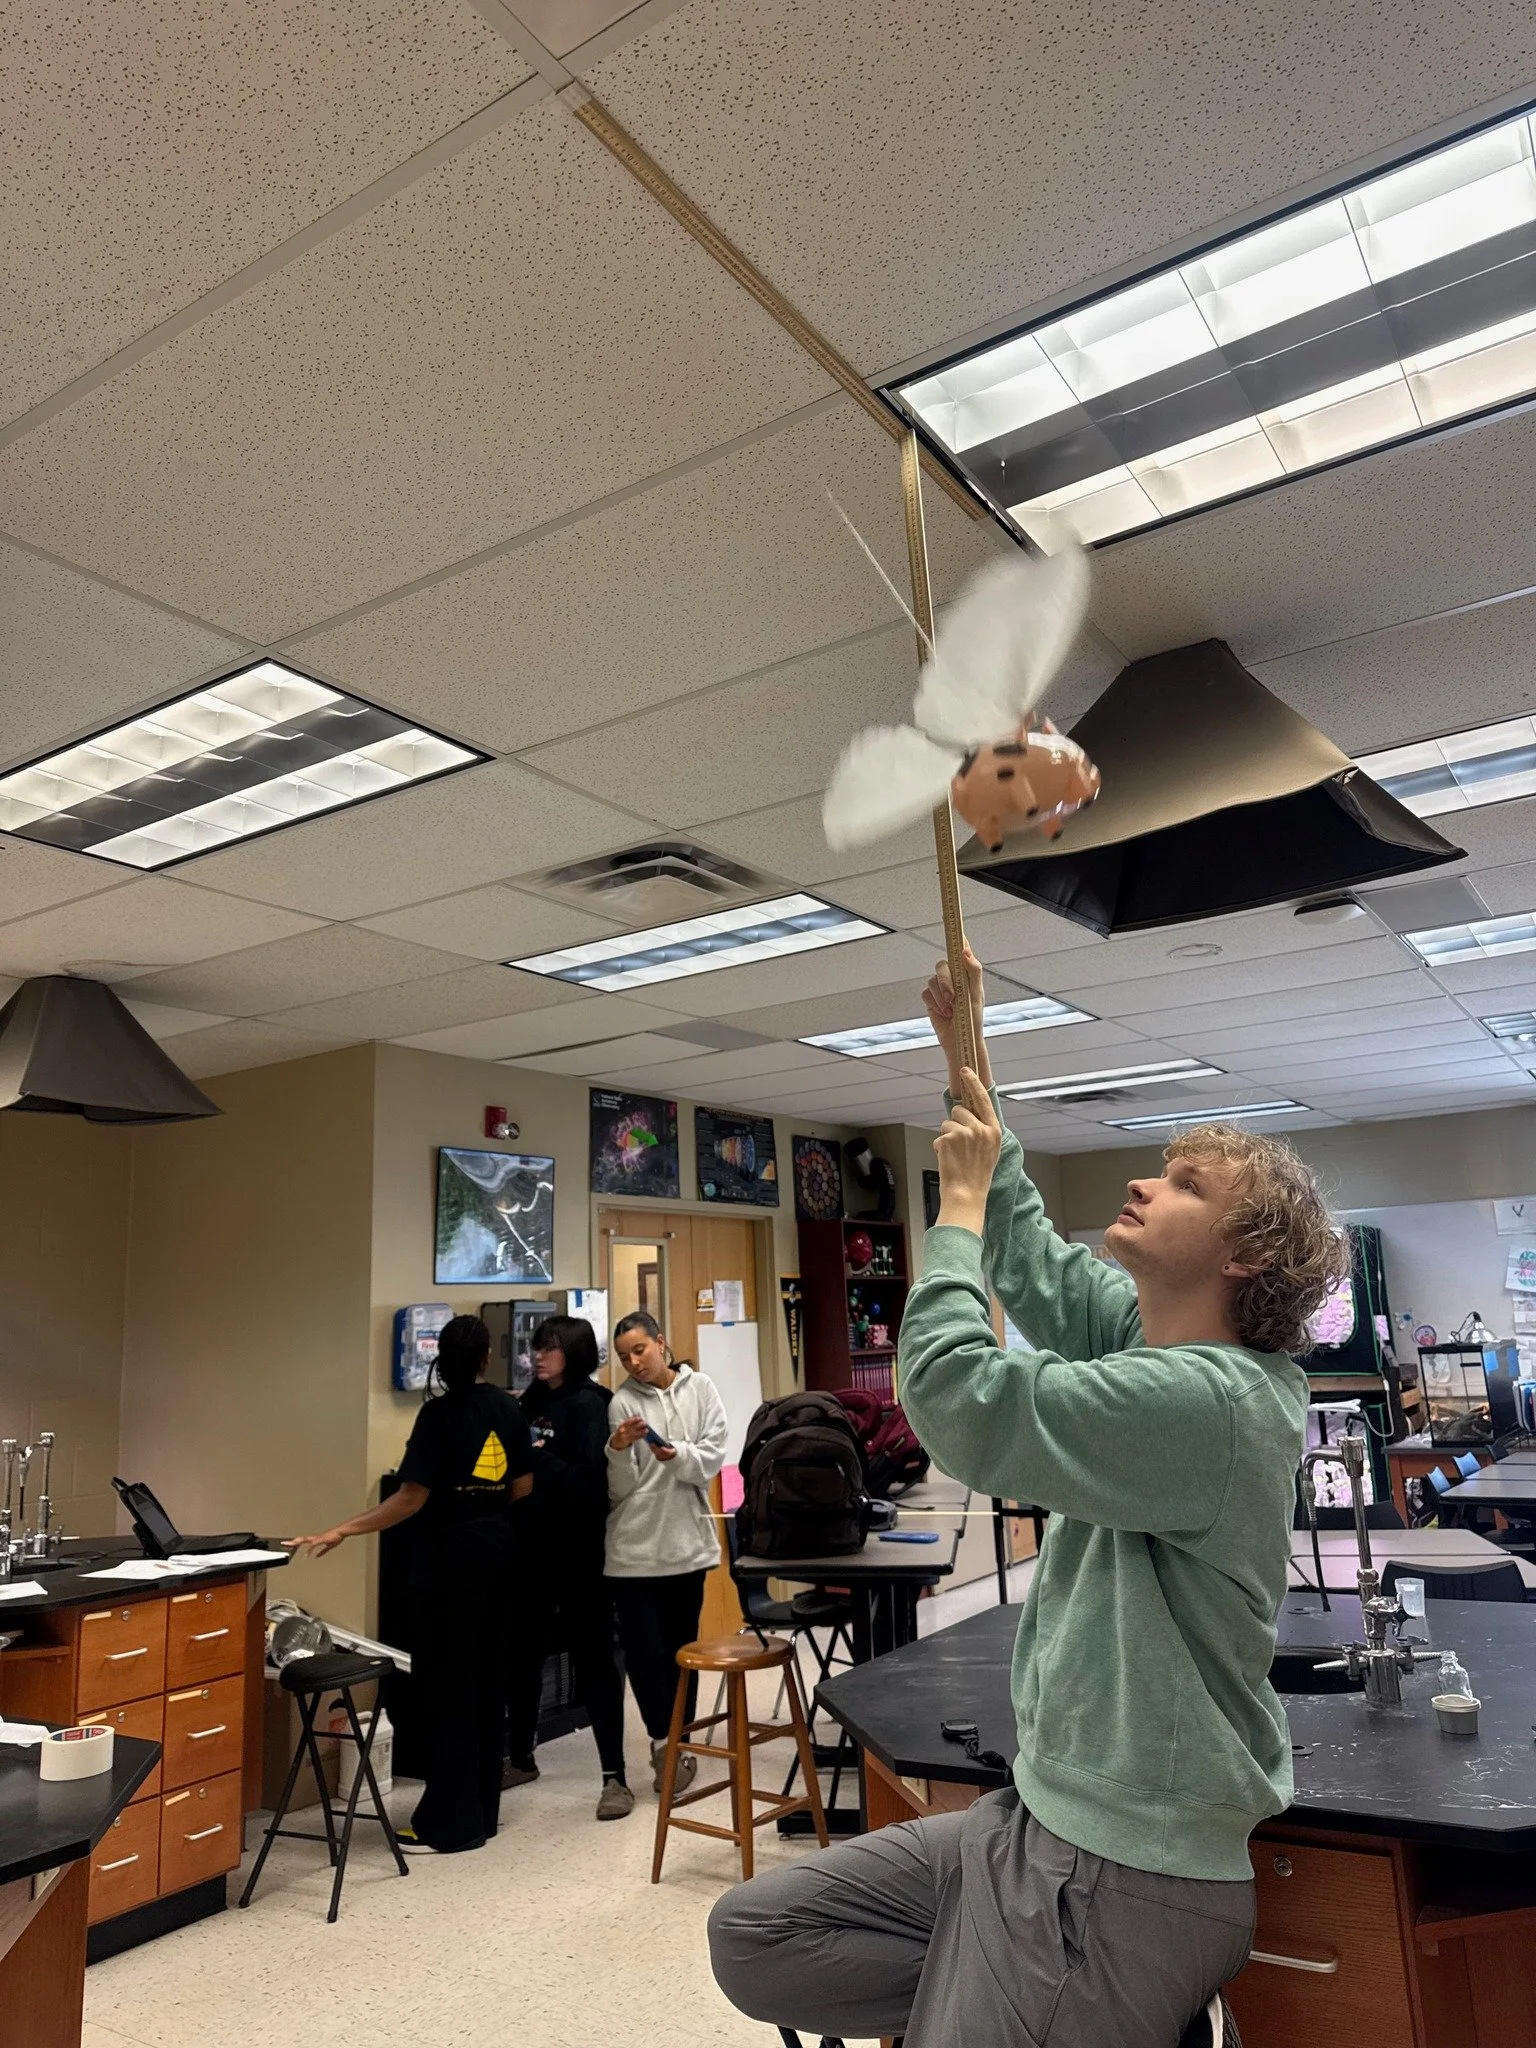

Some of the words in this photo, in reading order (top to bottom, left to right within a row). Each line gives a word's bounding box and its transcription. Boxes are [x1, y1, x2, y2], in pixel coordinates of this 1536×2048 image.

[626, 153, 634, 161] 10
[681, 210, 690, 219] 20
[790, 1309, 798, 1357] WALDEN
